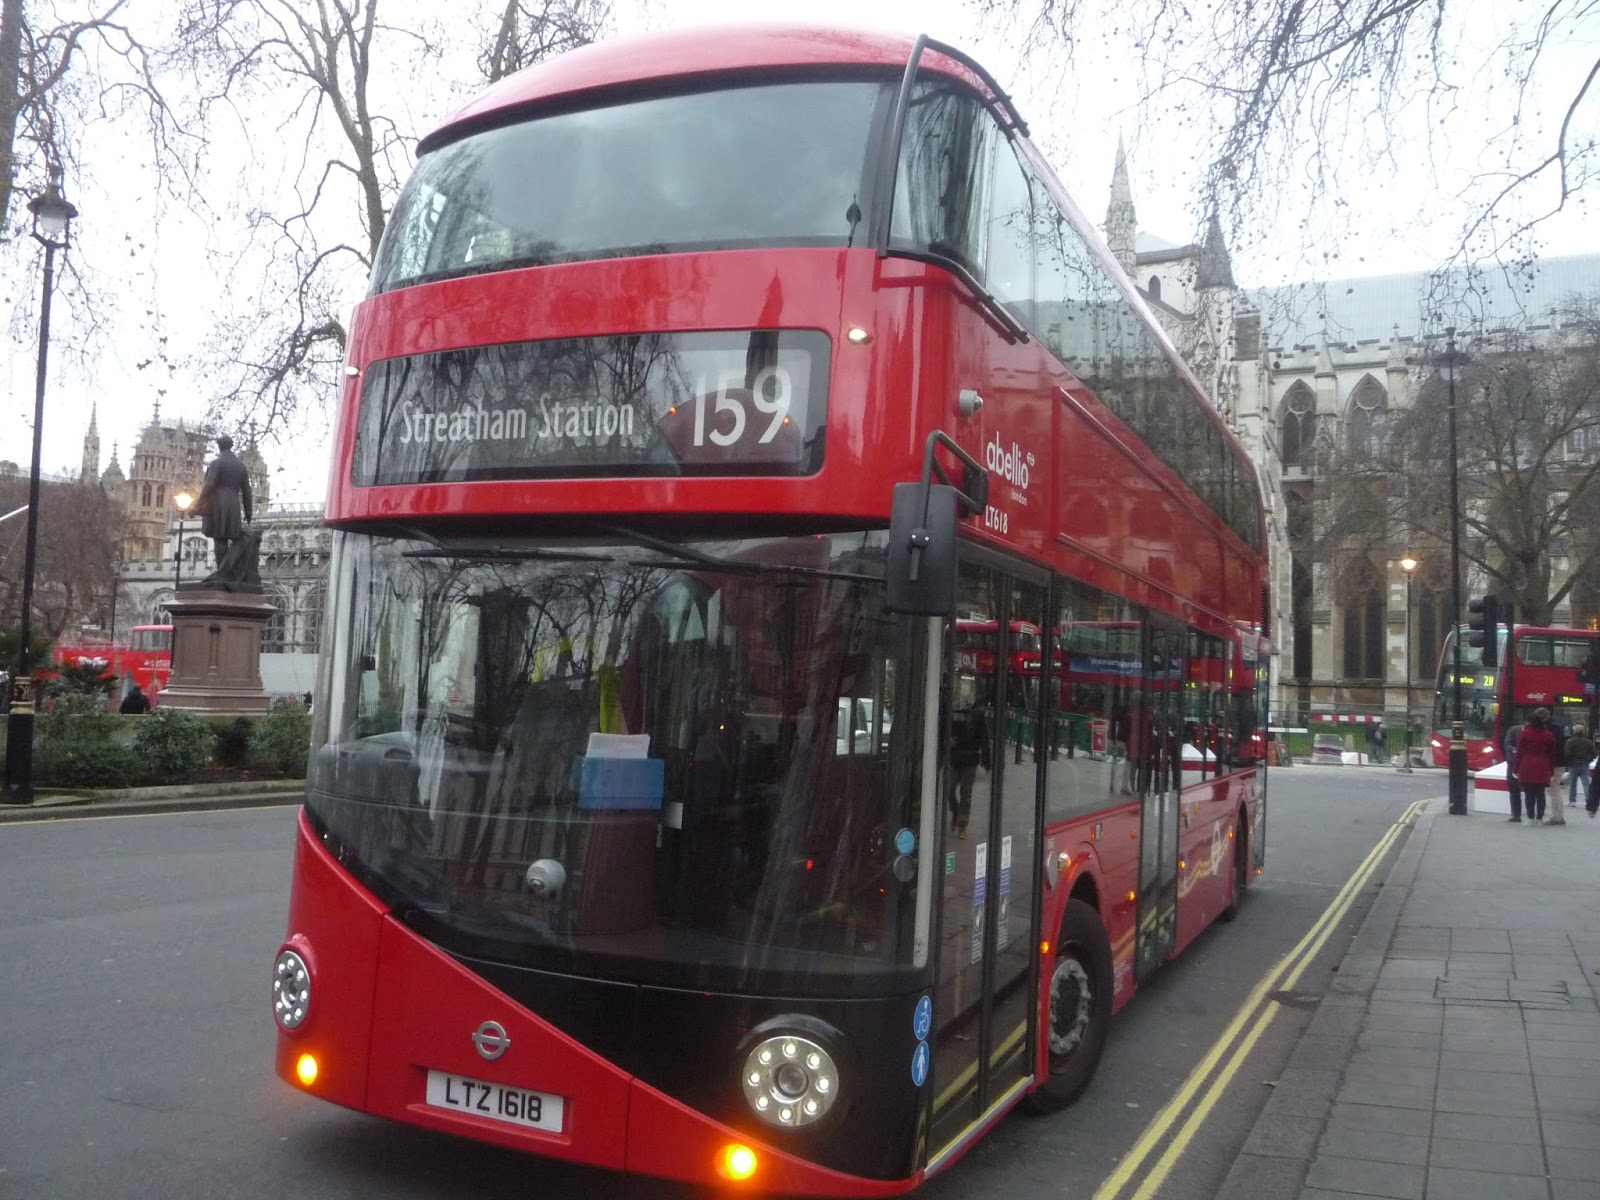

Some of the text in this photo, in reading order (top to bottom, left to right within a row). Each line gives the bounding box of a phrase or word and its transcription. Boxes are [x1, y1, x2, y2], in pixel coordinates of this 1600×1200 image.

[399, 365, 792, 447] Streatham Station 159
[986, 430, 1029, 490] abellio
[985, 504, 1008, 534] LT618
